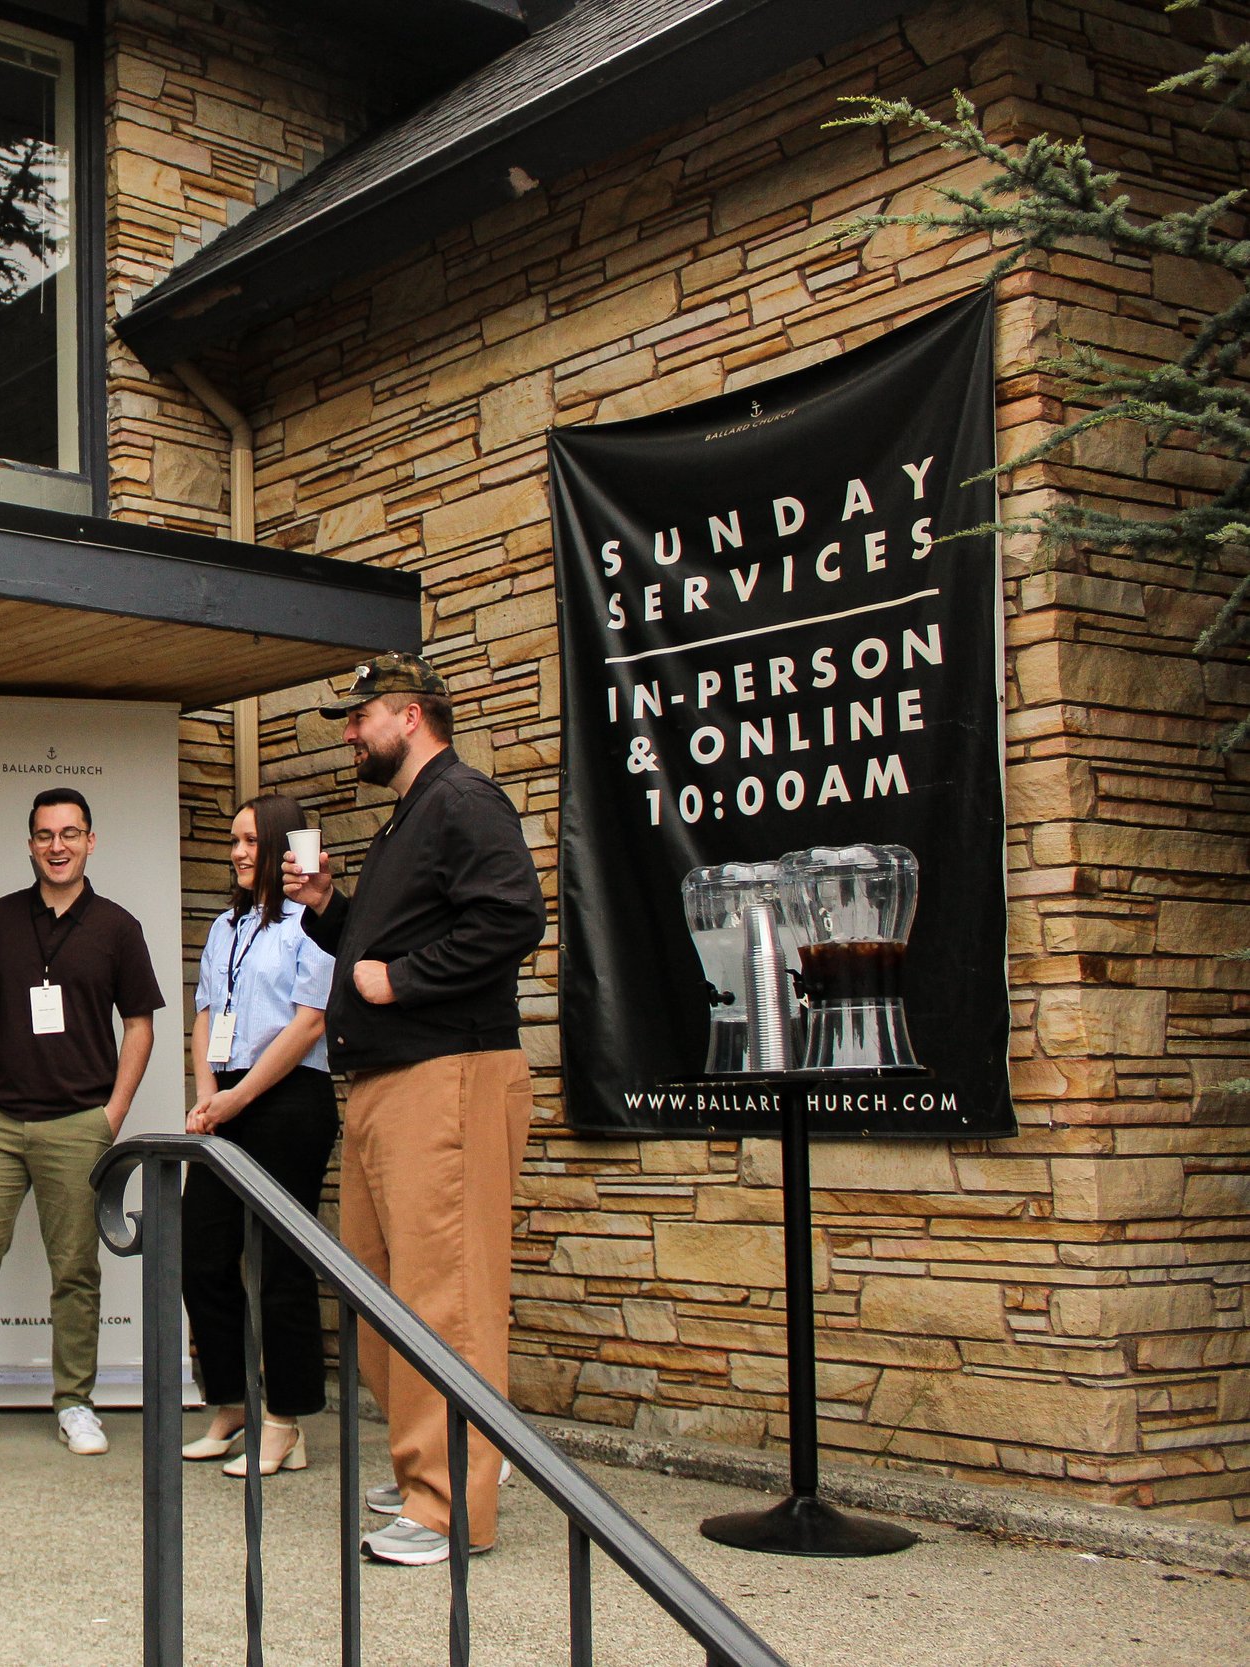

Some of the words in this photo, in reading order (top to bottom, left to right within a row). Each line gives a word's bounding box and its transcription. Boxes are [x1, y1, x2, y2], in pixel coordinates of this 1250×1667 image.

[705, 424, 750, 441] BALLARD
[752, 408, 797, 427] CHURCH
[601, 456, 934, 577] SUNDAY
[606, 517, 934, 630] SERVICES
[607, 623, 944, 723] IN-PERSON
[2, 763, 52, 775] BALLARD
[55, 764, 103, 776] CHURCH
[626, 736, 660, 774] &
[689, 689, 925, 765] ONLINE
[645, 754, 910, 826] 10:00AM
[624, 1092, 958, 1112] WWW.BALLARDHURCH.COM
